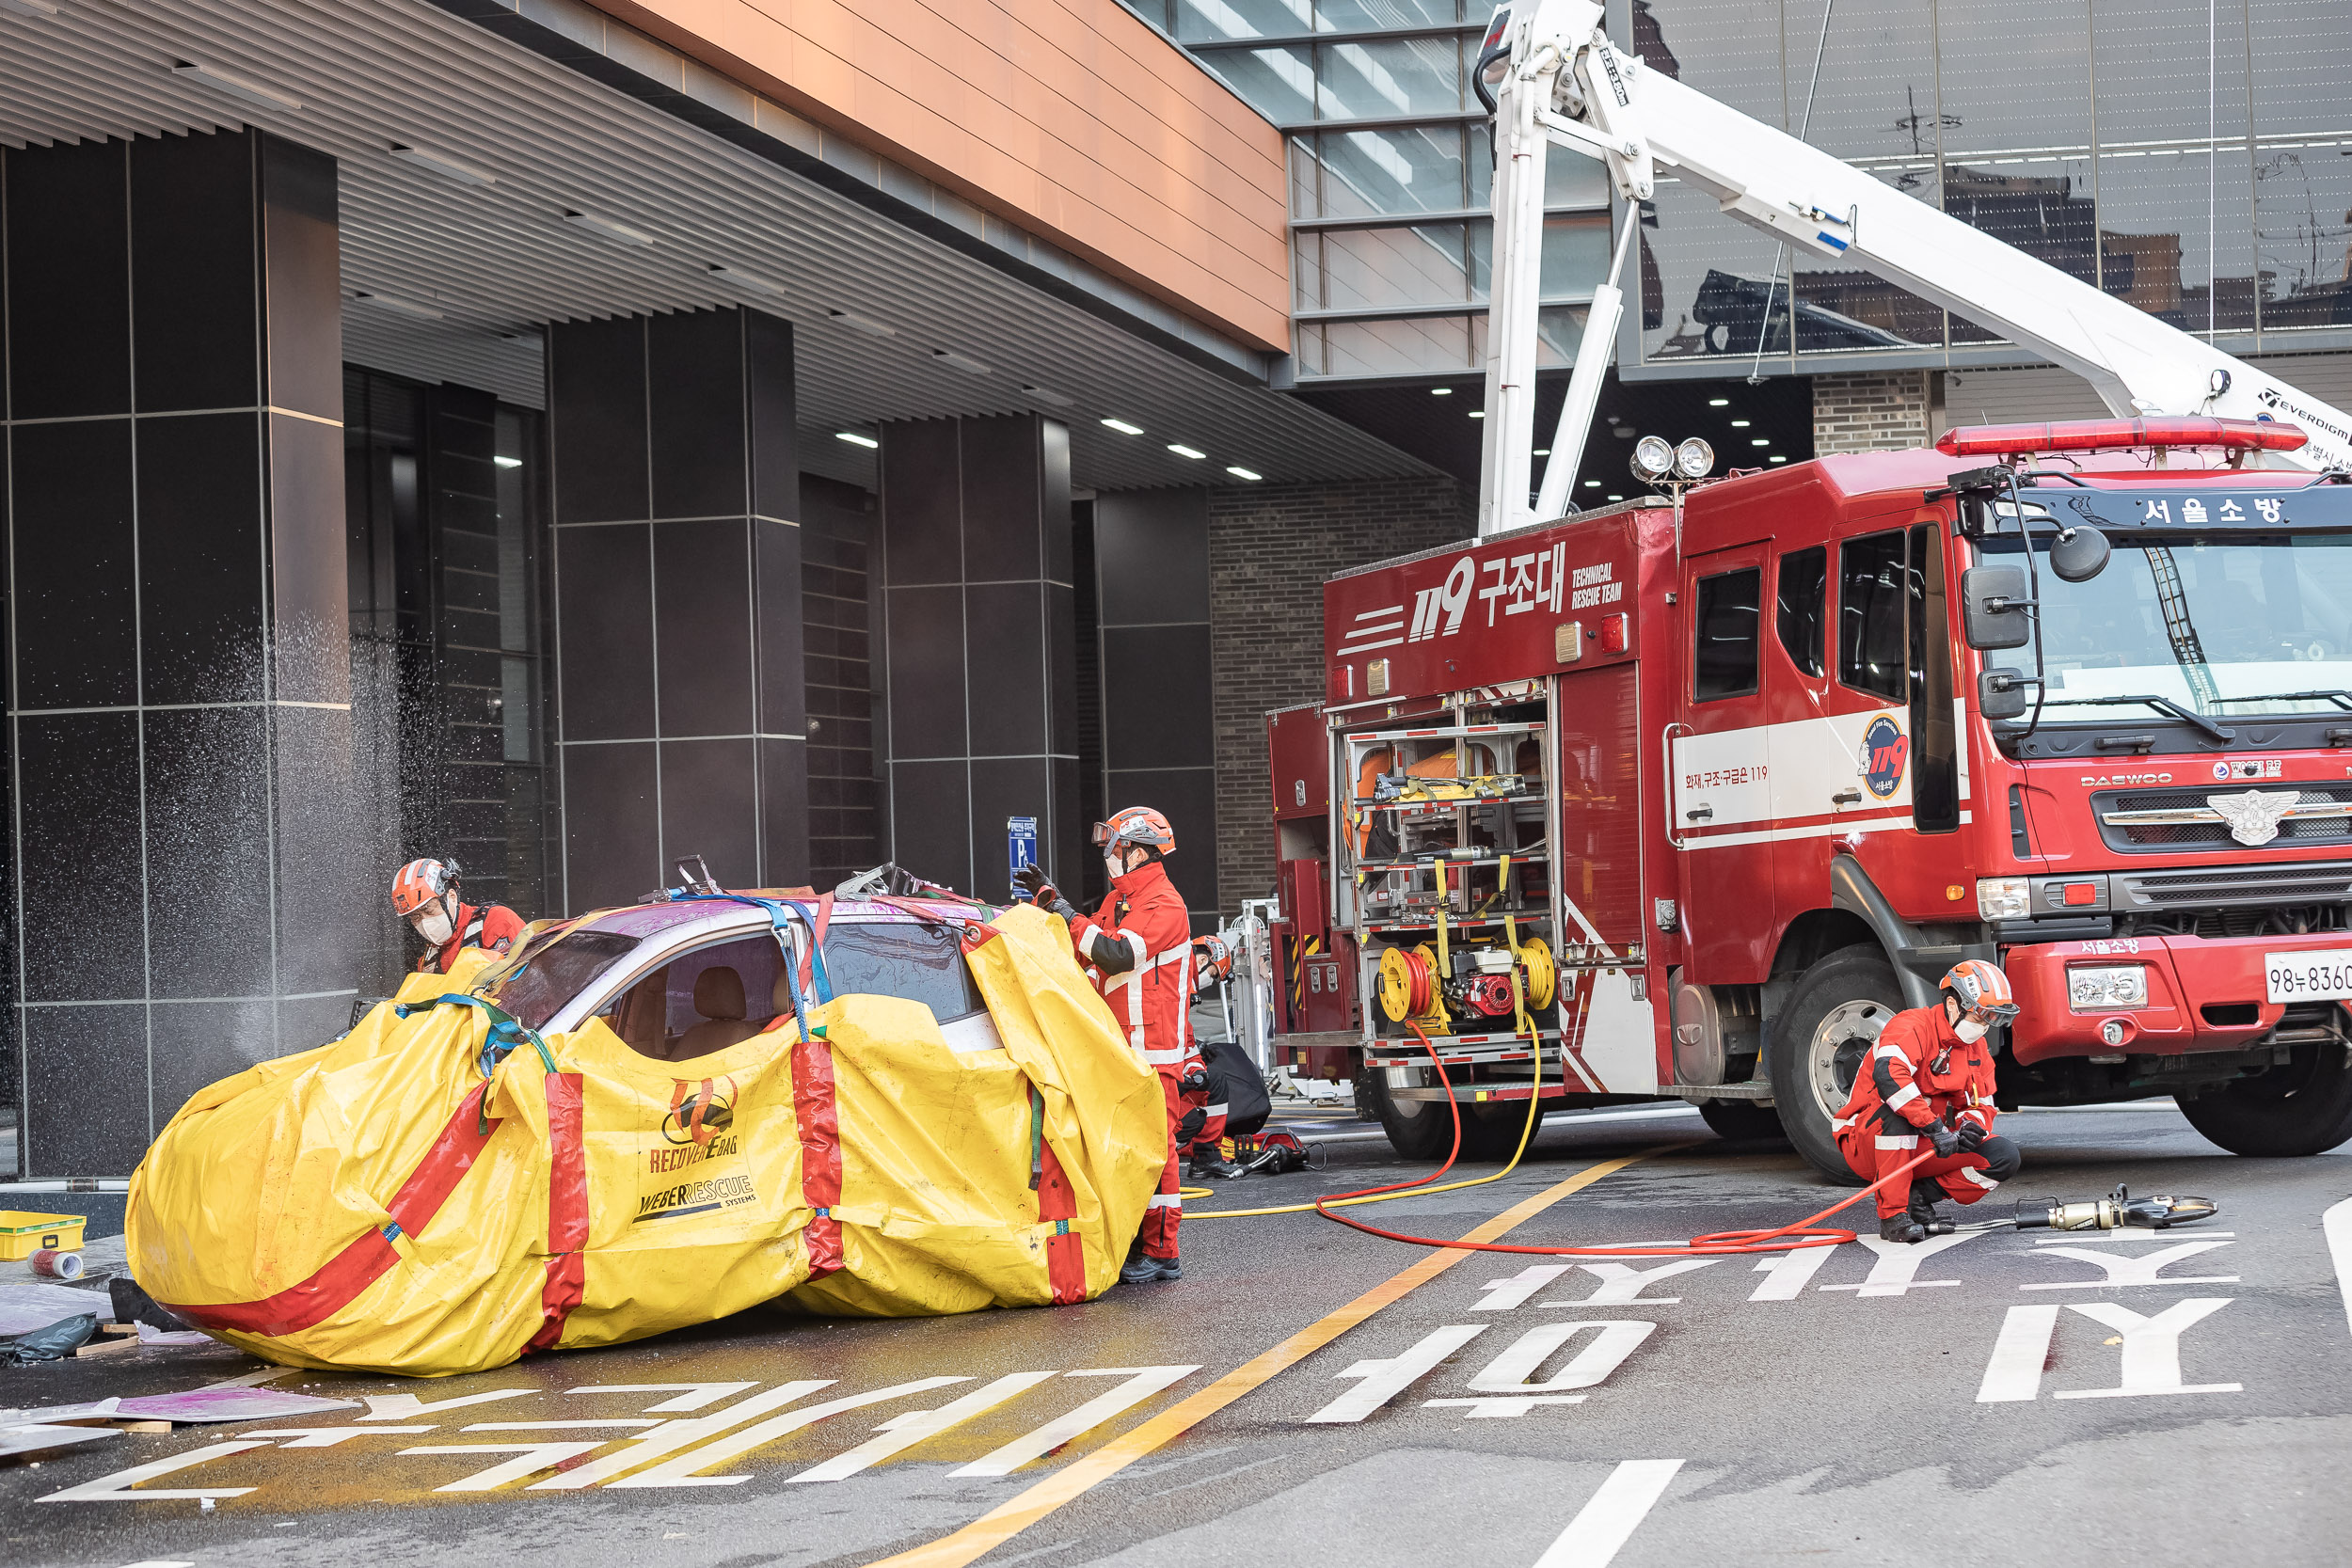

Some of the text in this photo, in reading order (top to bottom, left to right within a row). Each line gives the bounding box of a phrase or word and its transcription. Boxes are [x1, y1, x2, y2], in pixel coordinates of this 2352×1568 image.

[2280, 401, 2348, 440] EVERDIGM
[2145, 498, 2281, 524] 서울소방
[1572, 562, 1613, 589] TECHNICAL
[1408, 541, 1566, 643] 119 구조대
[1571, 581, 1623, 610] RESCUE TEAM
[1868, 734, 1909, 778] 119
[1751, 766, 1768, 781] 119
[2080, 772, 2173, 787] DAEWOO
[2081, 939, 2139, 956] 서울소방
[725, 1195, 756, 1207] SYSTEMS
